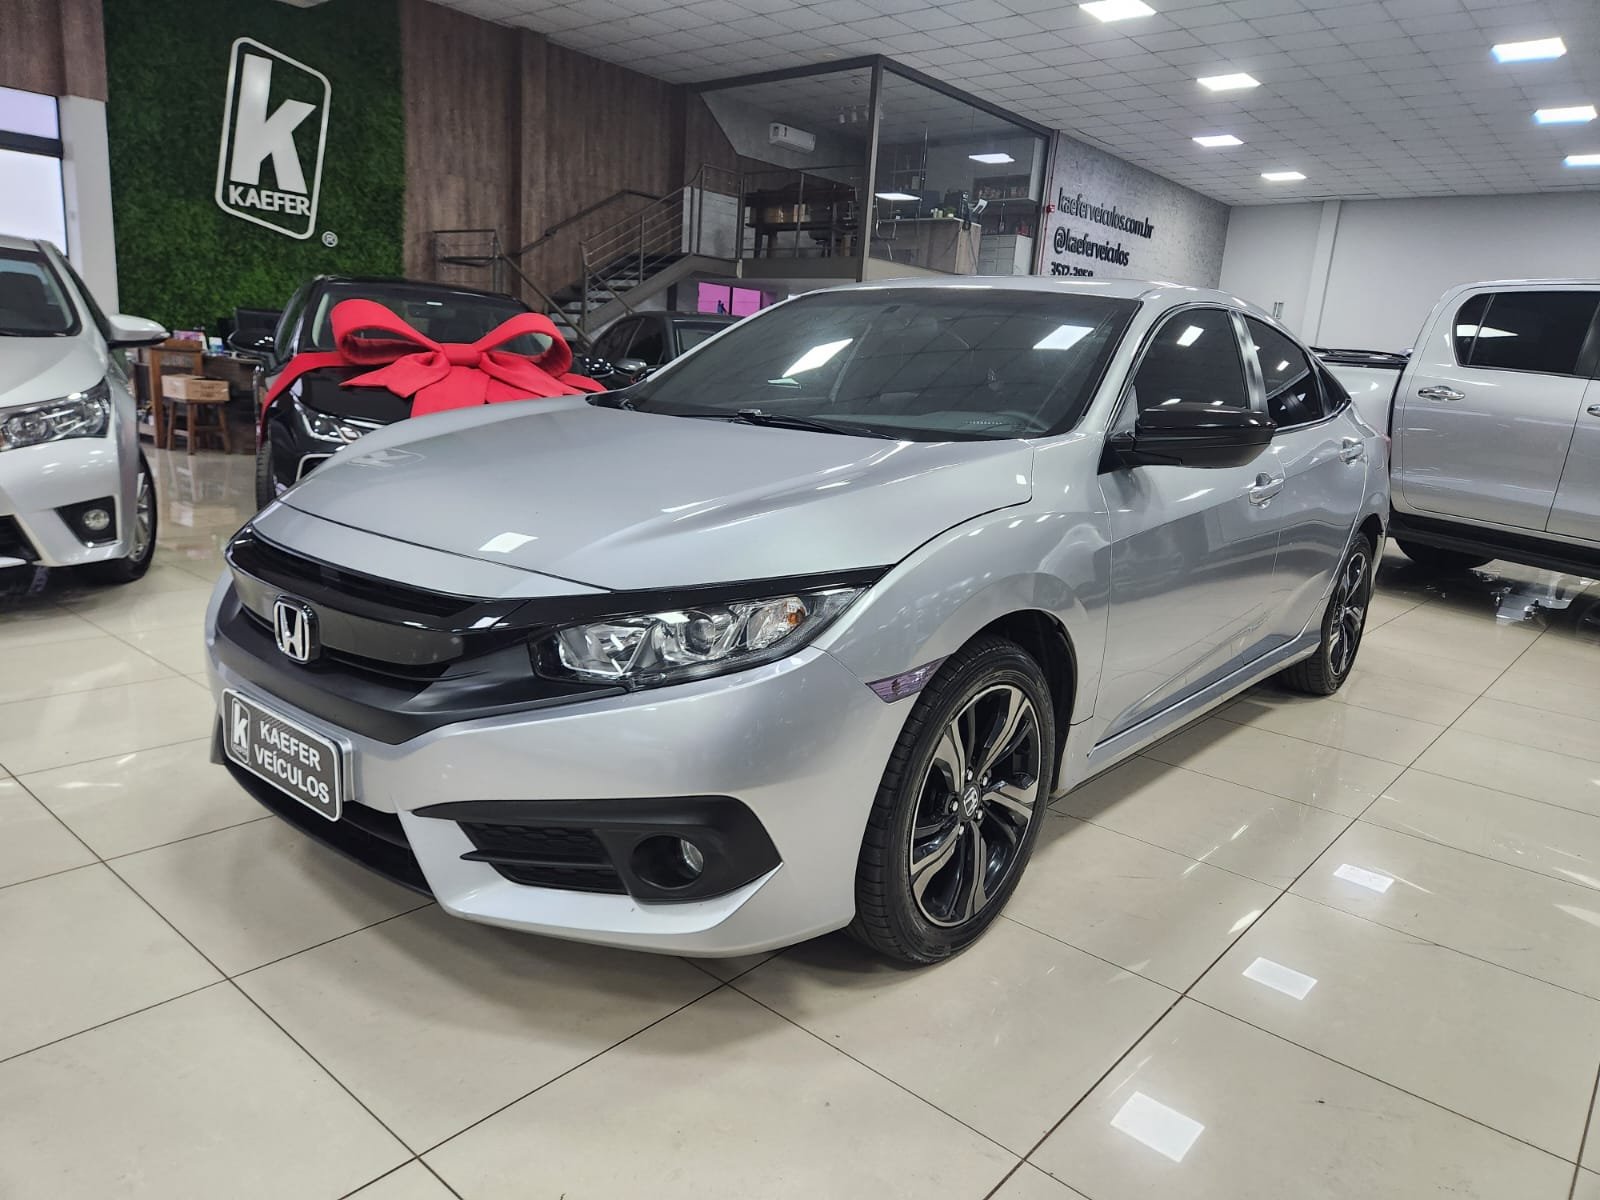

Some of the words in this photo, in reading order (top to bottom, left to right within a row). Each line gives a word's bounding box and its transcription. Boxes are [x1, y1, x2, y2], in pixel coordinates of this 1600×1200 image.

[229, 185, 311, 216] KAEFER
[1057, 187, 1154, 239] kaeferveiculos.com.br
[1053, 226, 1130, 266] @kaeferveiculos
[260, 720, 321, 772] KAEFER
[254, 743, 330, 804] VEÍCULOS
